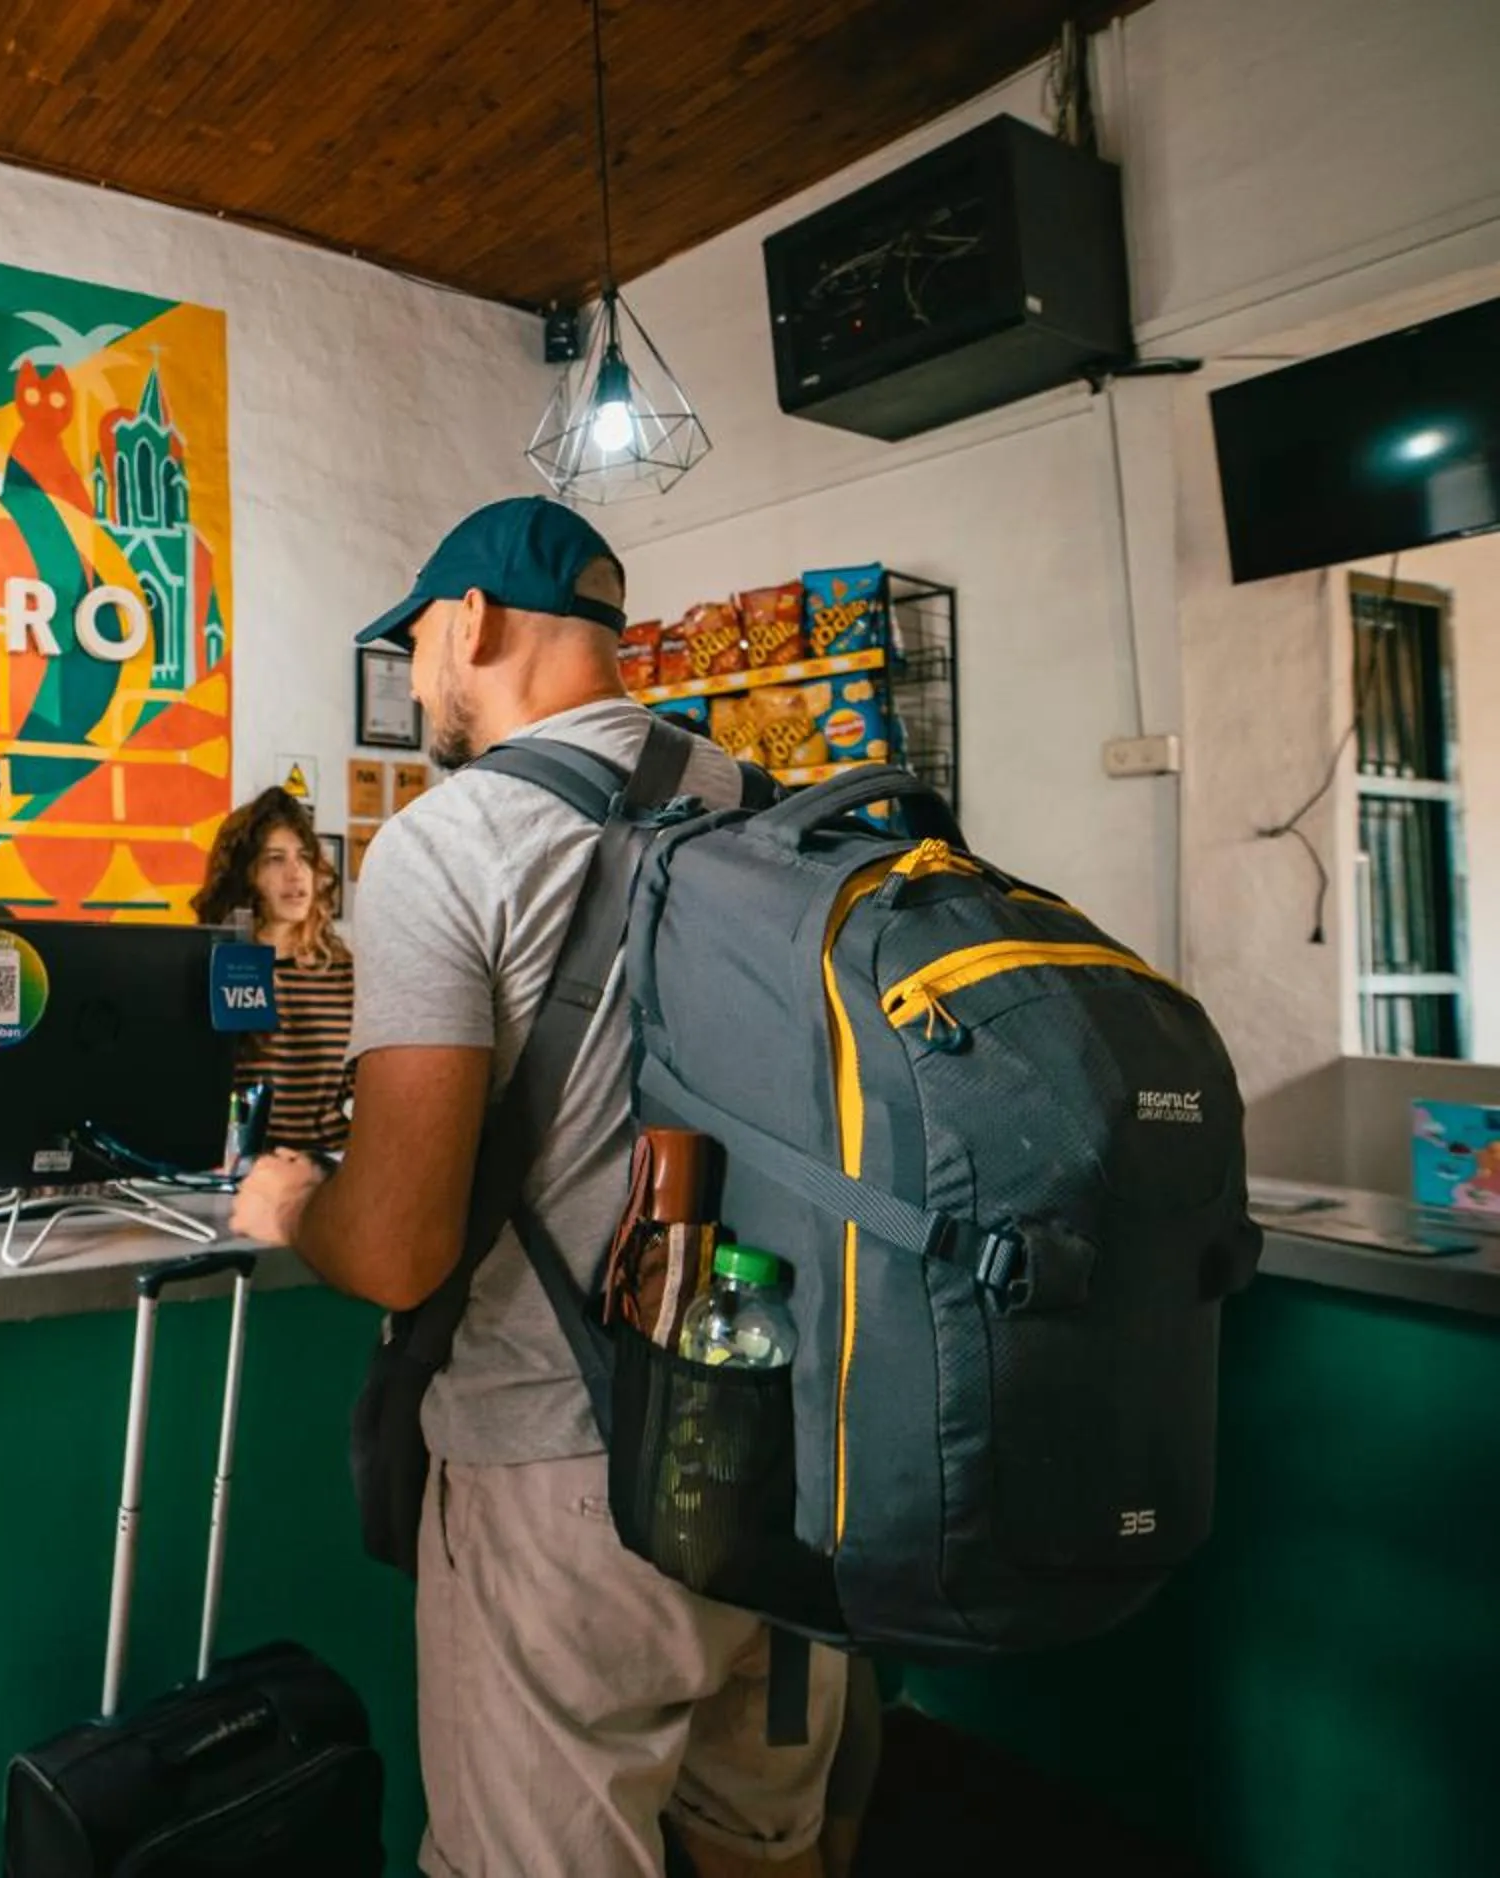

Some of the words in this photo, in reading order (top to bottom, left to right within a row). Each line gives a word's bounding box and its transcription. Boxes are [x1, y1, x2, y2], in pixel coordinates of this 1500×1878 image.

[220, 986, 268, 1008] VISA
[1139, 1091, 1183, 1108] REGATTA
[1120, 1509, 1156, 1536] 35
